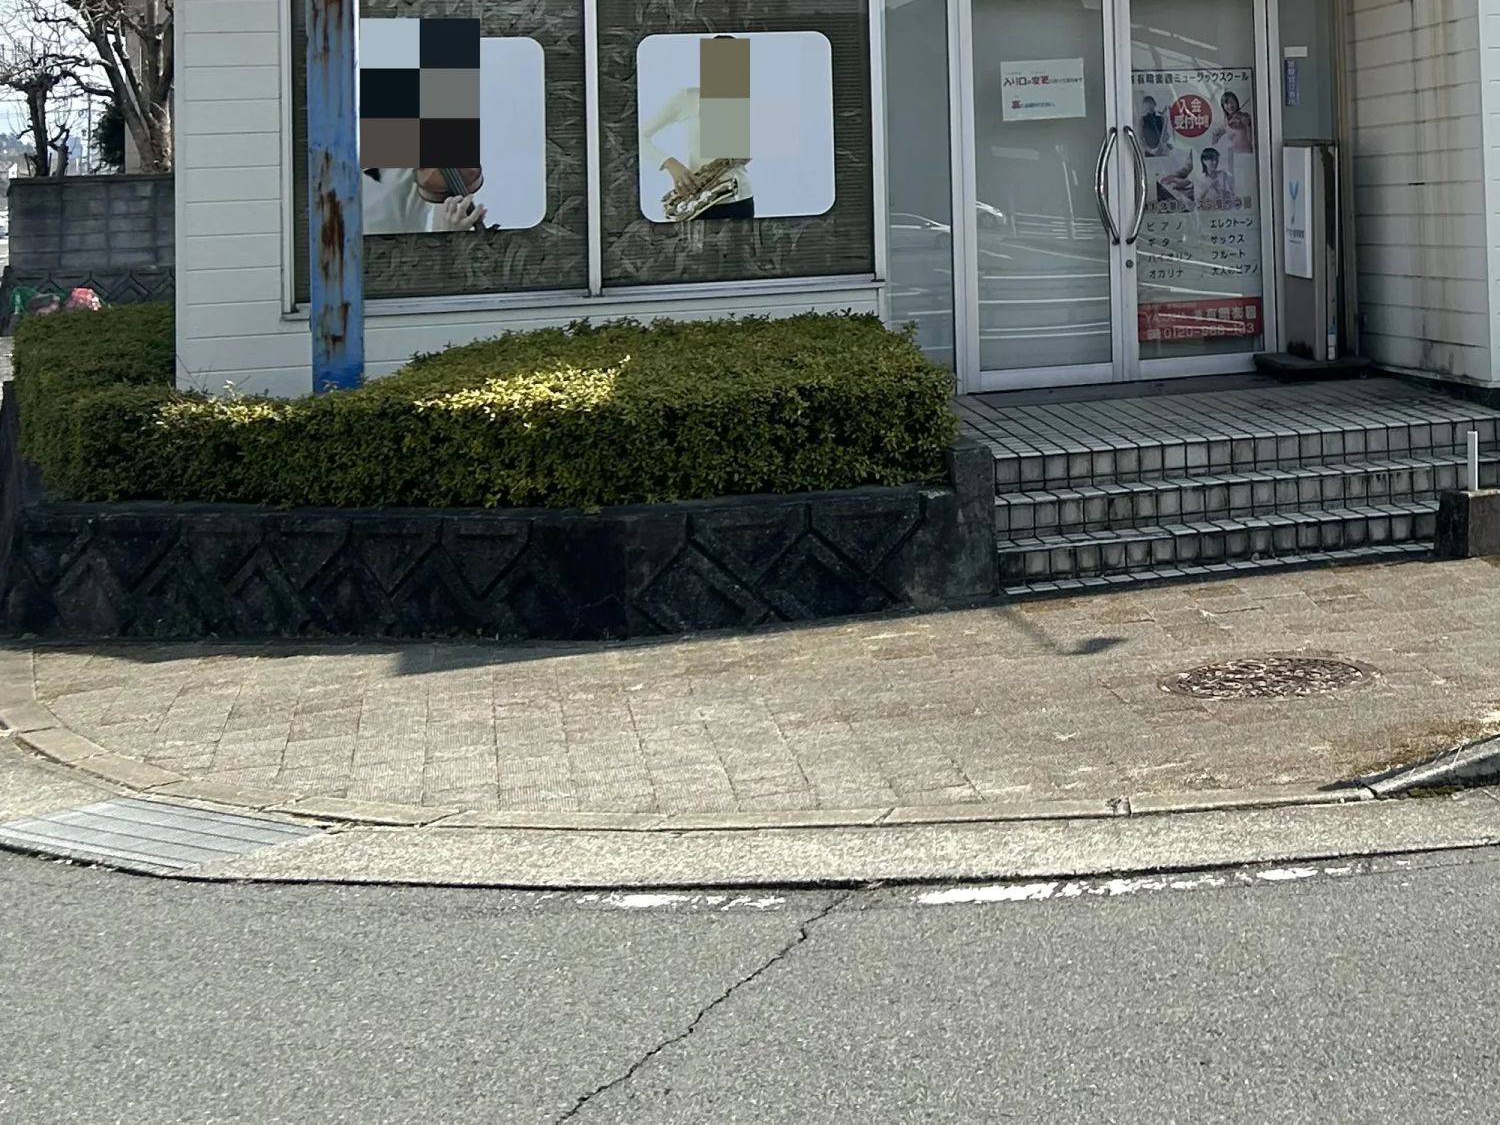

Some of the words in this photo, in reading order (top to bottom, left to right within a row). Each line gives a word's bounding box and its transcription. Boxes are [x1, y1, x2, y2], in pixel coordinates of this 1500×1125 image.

[1211, 234, 1246, 245] サックス
[1211, 249, 1246, 260] フルート
